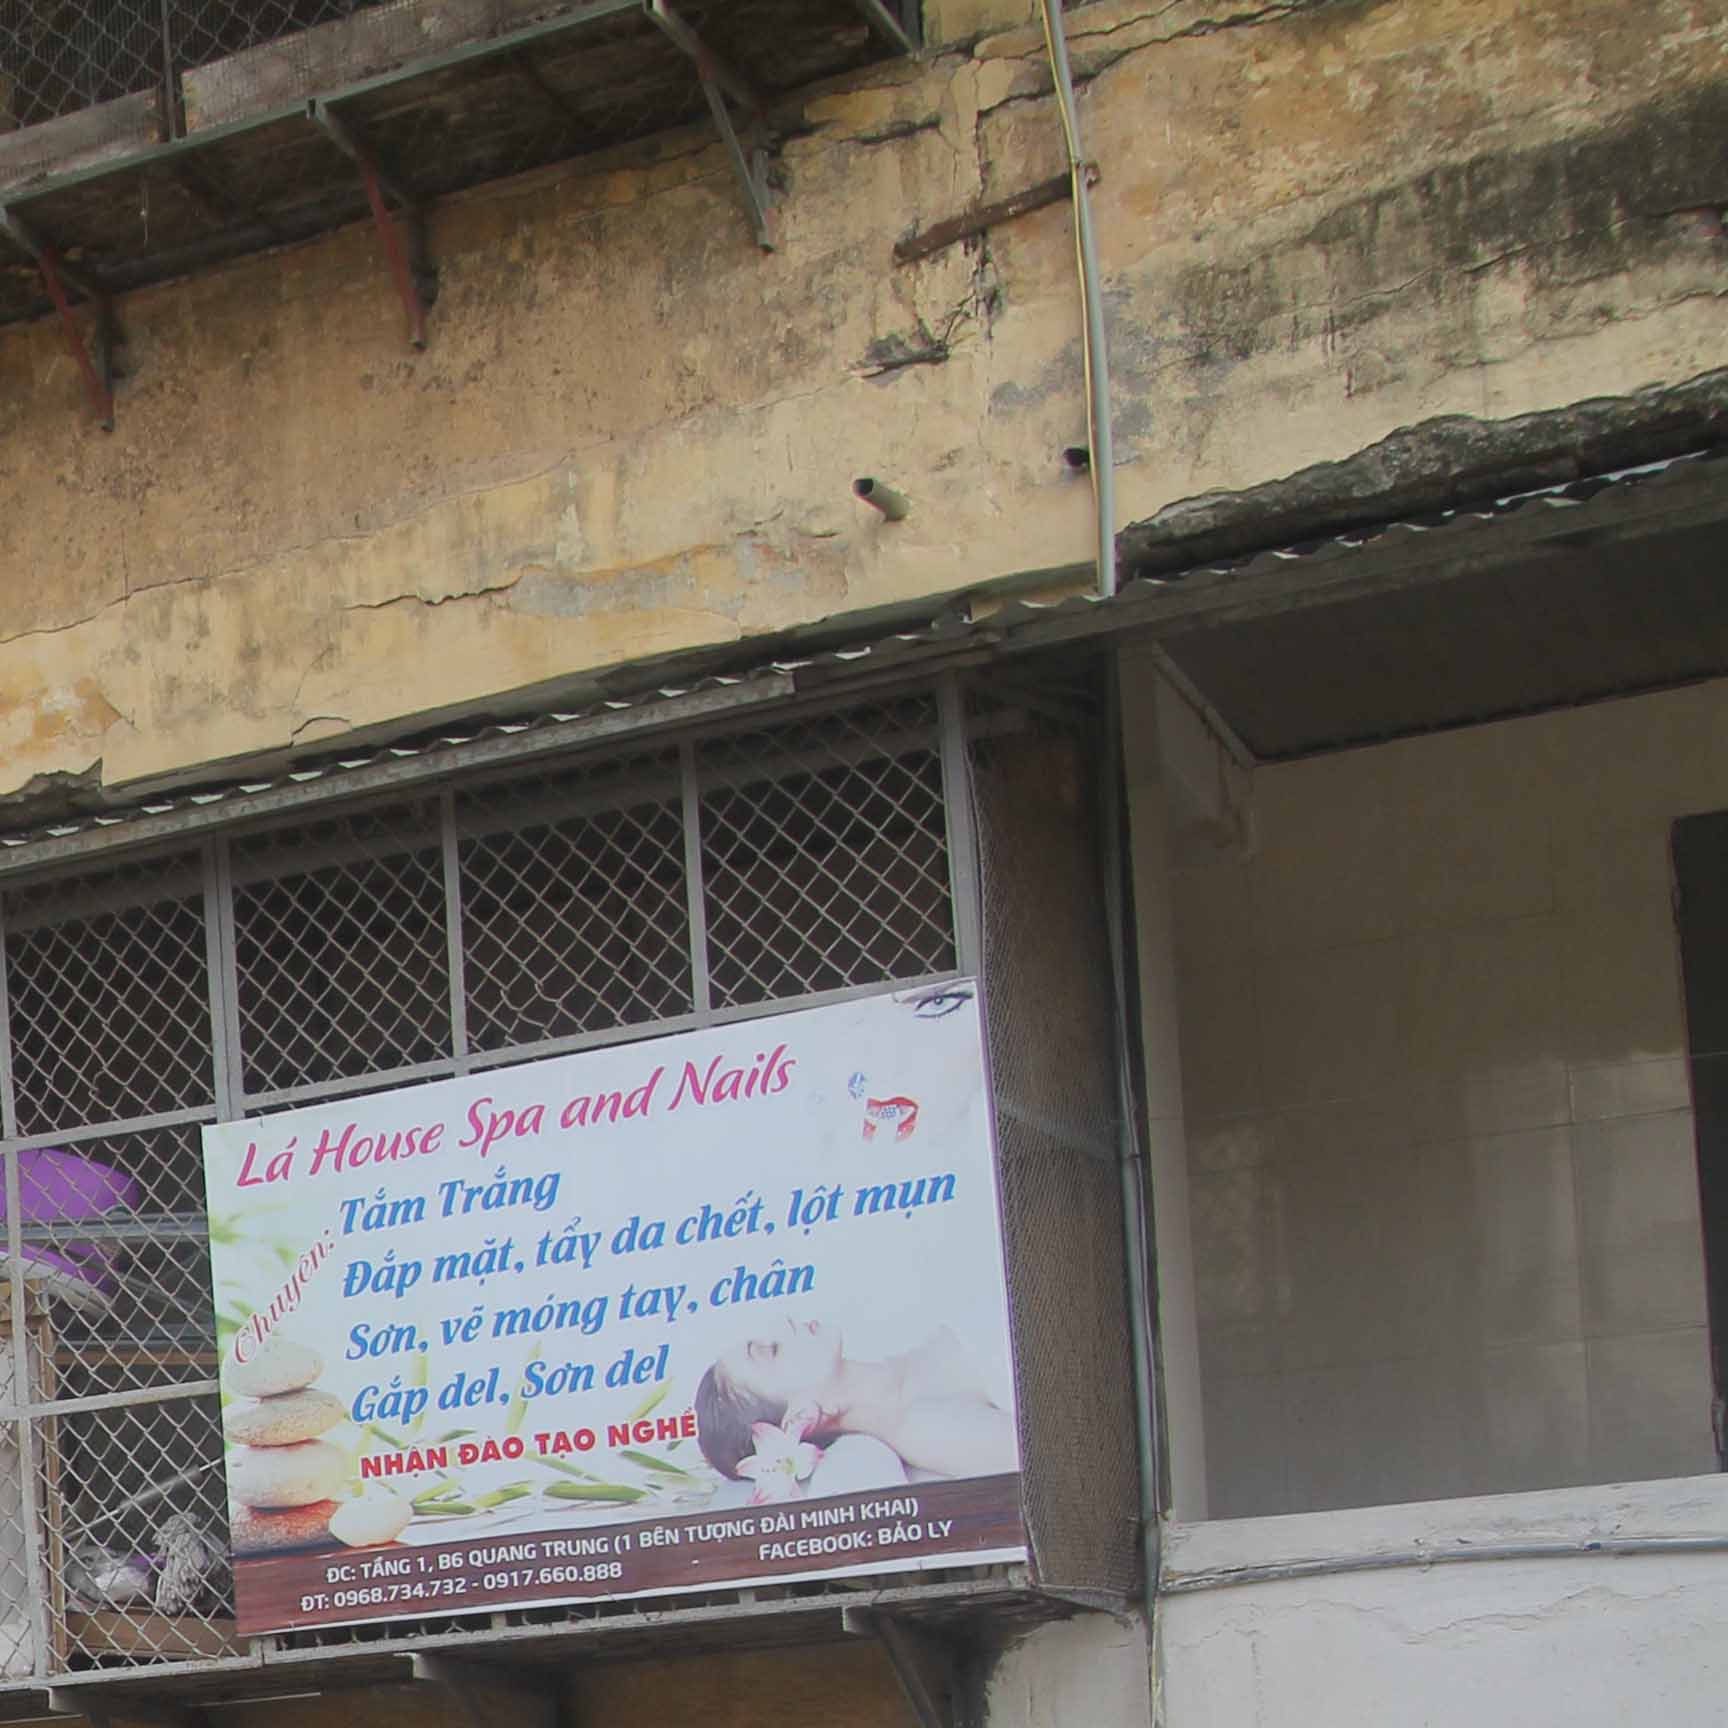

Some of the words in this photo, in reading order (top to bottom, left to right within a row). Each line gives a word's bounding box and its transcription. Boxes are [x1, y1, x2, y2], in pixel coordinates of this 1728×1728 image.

[236, 1137, 297, 1186] Lá
[309, 1122, 445, 1176] House
[458, 1097, 545, 1157] Spa
[560, 1067, 664, 1129] and
[667, 1044, 797, 1111] Nails
[339, 1187, 425, 1235] Tắm
[438, 1165, 561, 1218] Trắng
[343, 1248, 422, 1298] Đắp
[431, 1237, 524, 1286] mặt,
[536, 1215, 601, 1269] tẩy
[611, 1216, 665, 1255] da
[675, 1189, 775, 1246] chết,
[787, 1184, 845, 1236] lột
[853, 1171, 956, 1220] mụn
[345, 1323, 428, 1361] Sơn,
[439, 1305, 483, 1346] vẽ
[492, 1293, 610, 1337] móng
[618, 1283, 699, 1323] tay,
[710, 1258, 816, 1307] chân
[351, 1376, 429, 1426] Gắp
[438, 1367, 510, 1411] del,
[521, 1360, 595, 1399] Sơn
[605, 1344, 671, 1389] del
[360, 1446, 449, 1479] NHẬN
[457, 1435, 524, 1466] ĐÀO
[534, 1428, 596, 1459] TẠO
[326, 1565, 357, 1585] ĐC:
[417, 1556, 433, 1574] 1,
[438, 1552, 464, 1571] B6
[469, 1543, 537, 1569] QUANG
[541, 1536, 610, 1558] TRUNG
[614, 1533, 631, 1554] (1
[639, 1526, 680, 1549] BÊN
[684, 1518, 756, 1544] TƯỢNG
[759, 1511, 794, 1534] ĐÀI
[801, 1505, 856, 1529] MINH
[860, 1497, 920, 1520] KHAI)
[759, 1532, 874, 1561] FACEBOOK:
[877, 1520, 922, 1545] BẢO
[927, 1519, 953, 1539] LY
[300, 1595, 330, 1612] ĐT:
[333, 1576, 468, 1609] 0968.734.732
[482, 1560, 623, 1591] 0917.660.888
